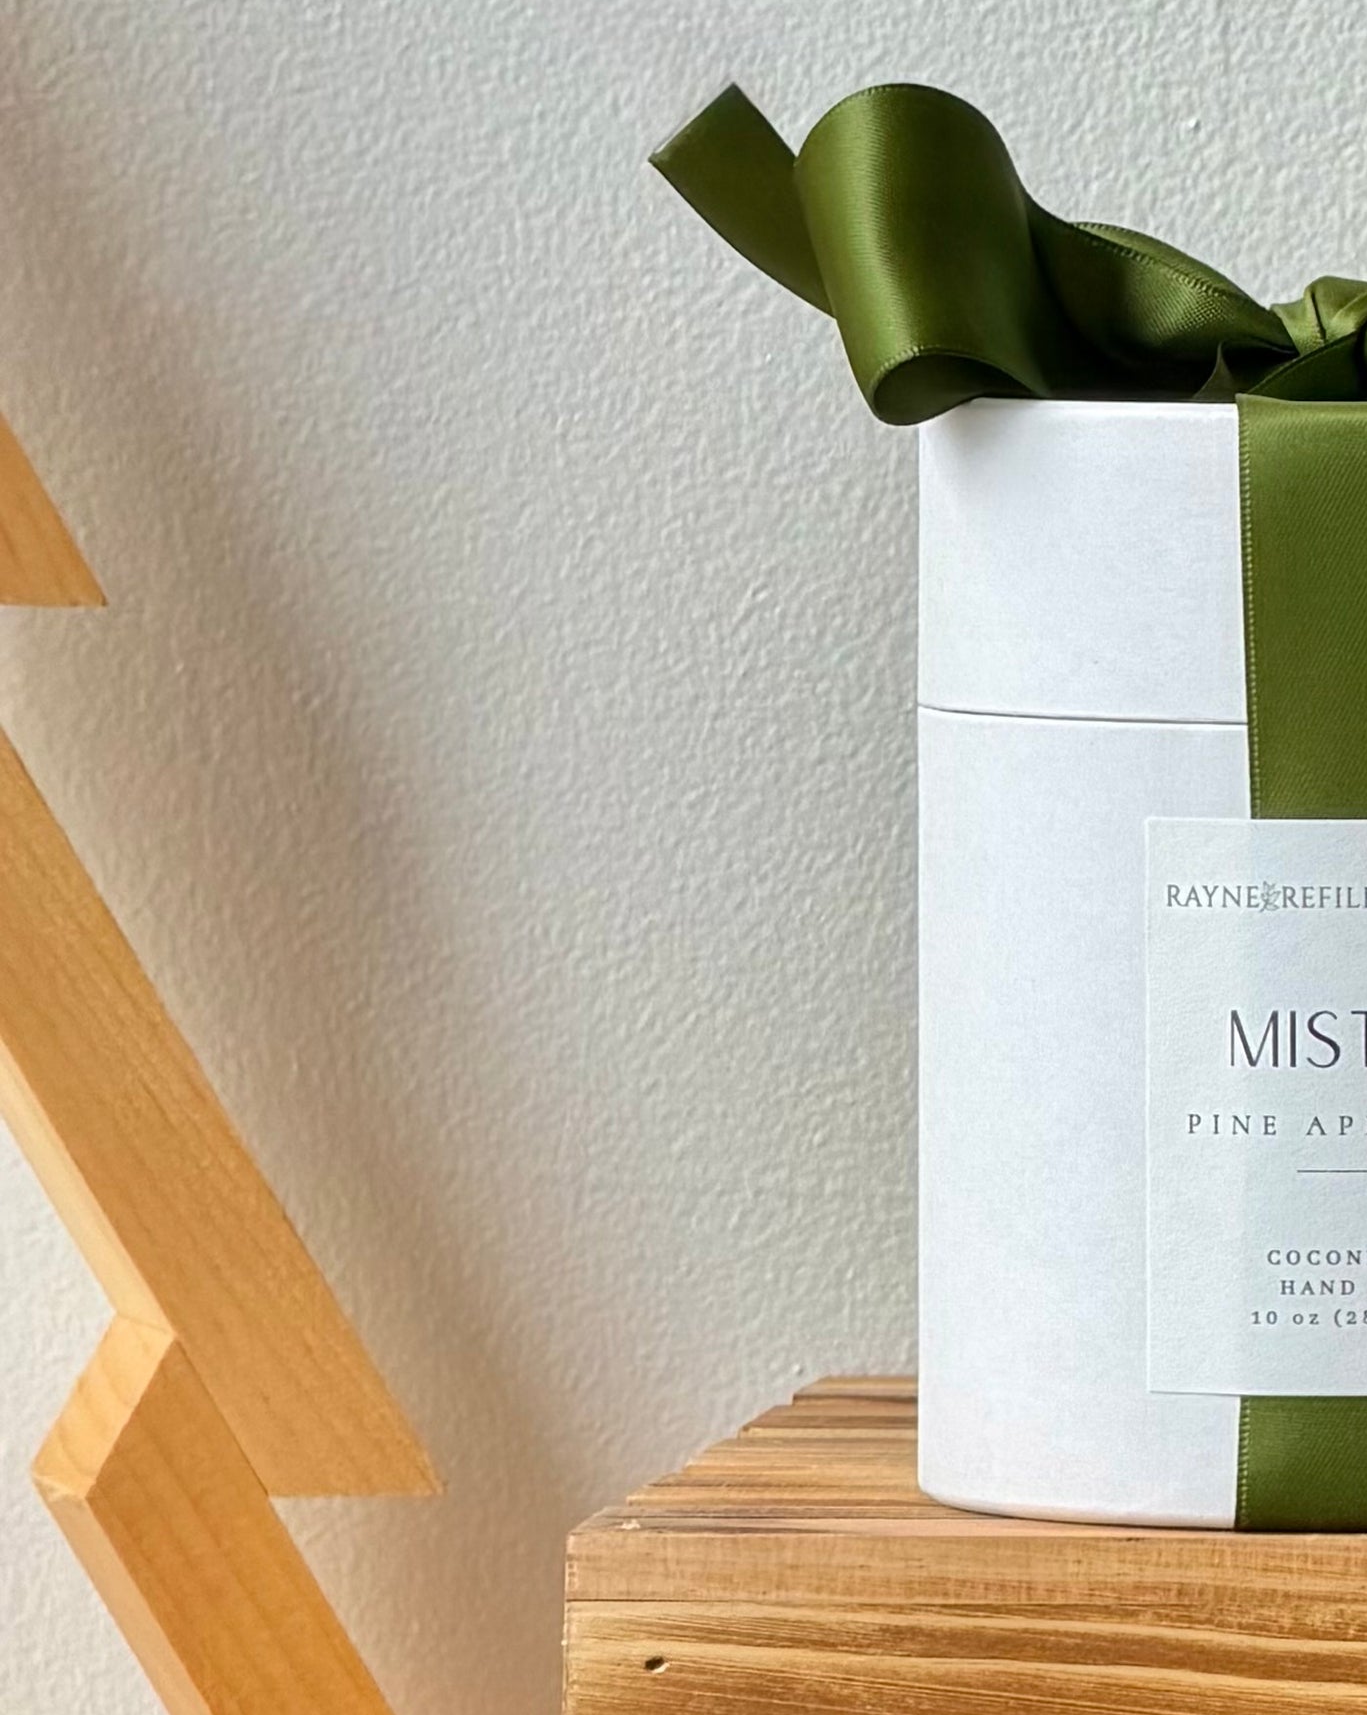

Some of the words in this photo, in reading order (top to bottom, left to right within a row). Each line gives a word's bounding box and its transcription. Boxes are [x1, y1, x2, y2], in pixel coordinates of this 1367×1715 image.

[1166, 884, 1260, 909] RAYNE
[1188, 1113, 1277, 1136] PINE
[1280, 1279, 1356, 1296] HAND
[1251, 1310, 1278, 1325] 10
[1292, 1313, 1320, 1326] oz
